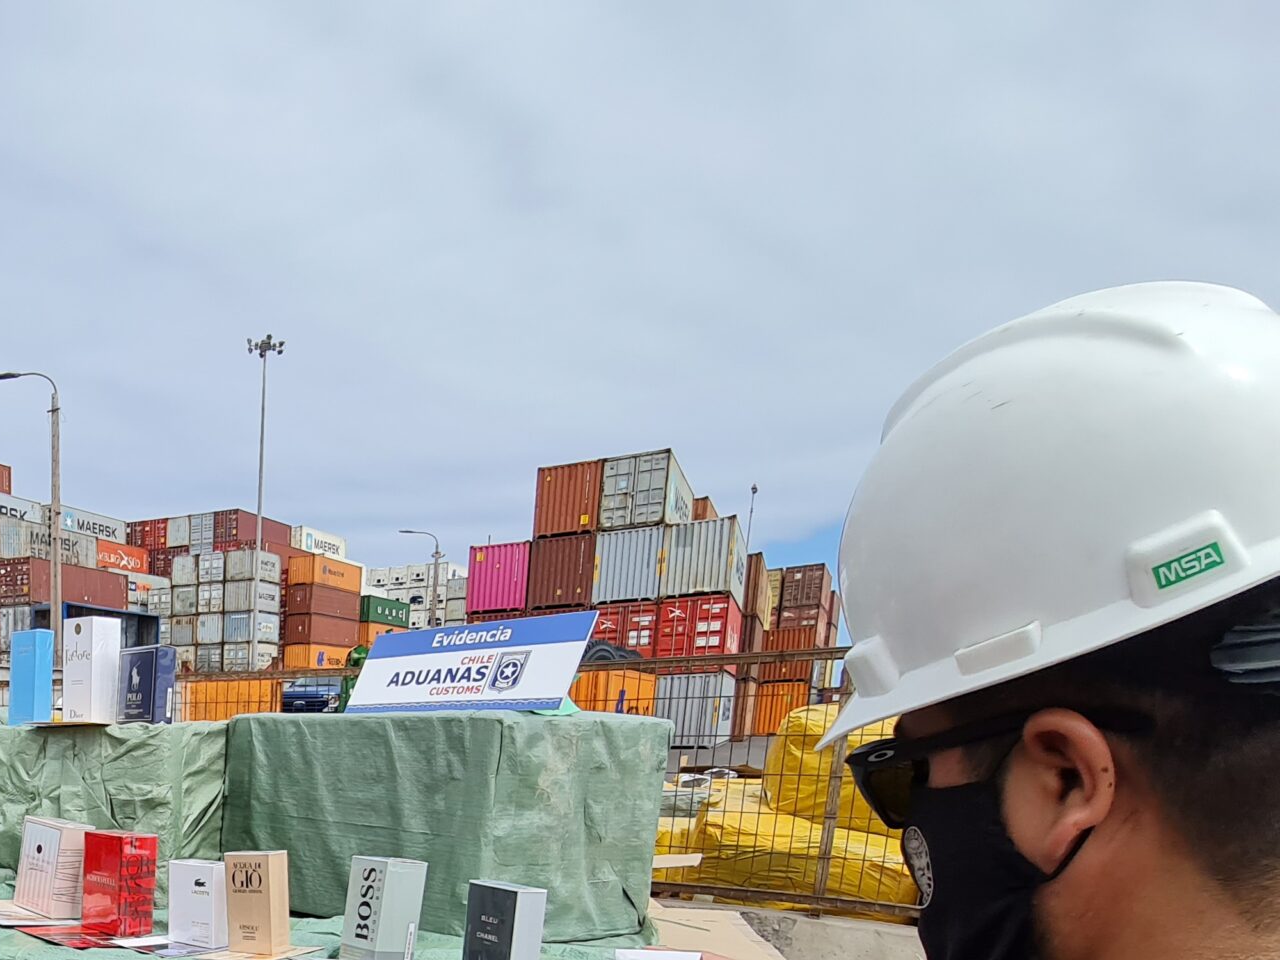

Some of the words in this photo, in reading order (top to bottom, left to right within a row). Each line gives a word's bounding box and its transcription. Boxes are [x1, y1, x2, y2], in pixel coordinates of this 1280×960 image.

[77, 518, 117, 540] MAERSK
[30, 531, 79, 553] MASK
[314, 538, 341, 556] MAERSK
[1158, 547, 1221, 586] MSA
[431, 625, 512, 648] Evidencia
[460, 654, 495, 666] CHILE
[386, 665, 489, 688] ADUANAS
[429, 684, 482, 696] CUSTOMS
[232, 869, 262, 889] GIÒ
[355, 867, 376, 940] BOSS
[481, 915, 498, 924] BLEU
[476, 931, 498, 942] CHANEL
